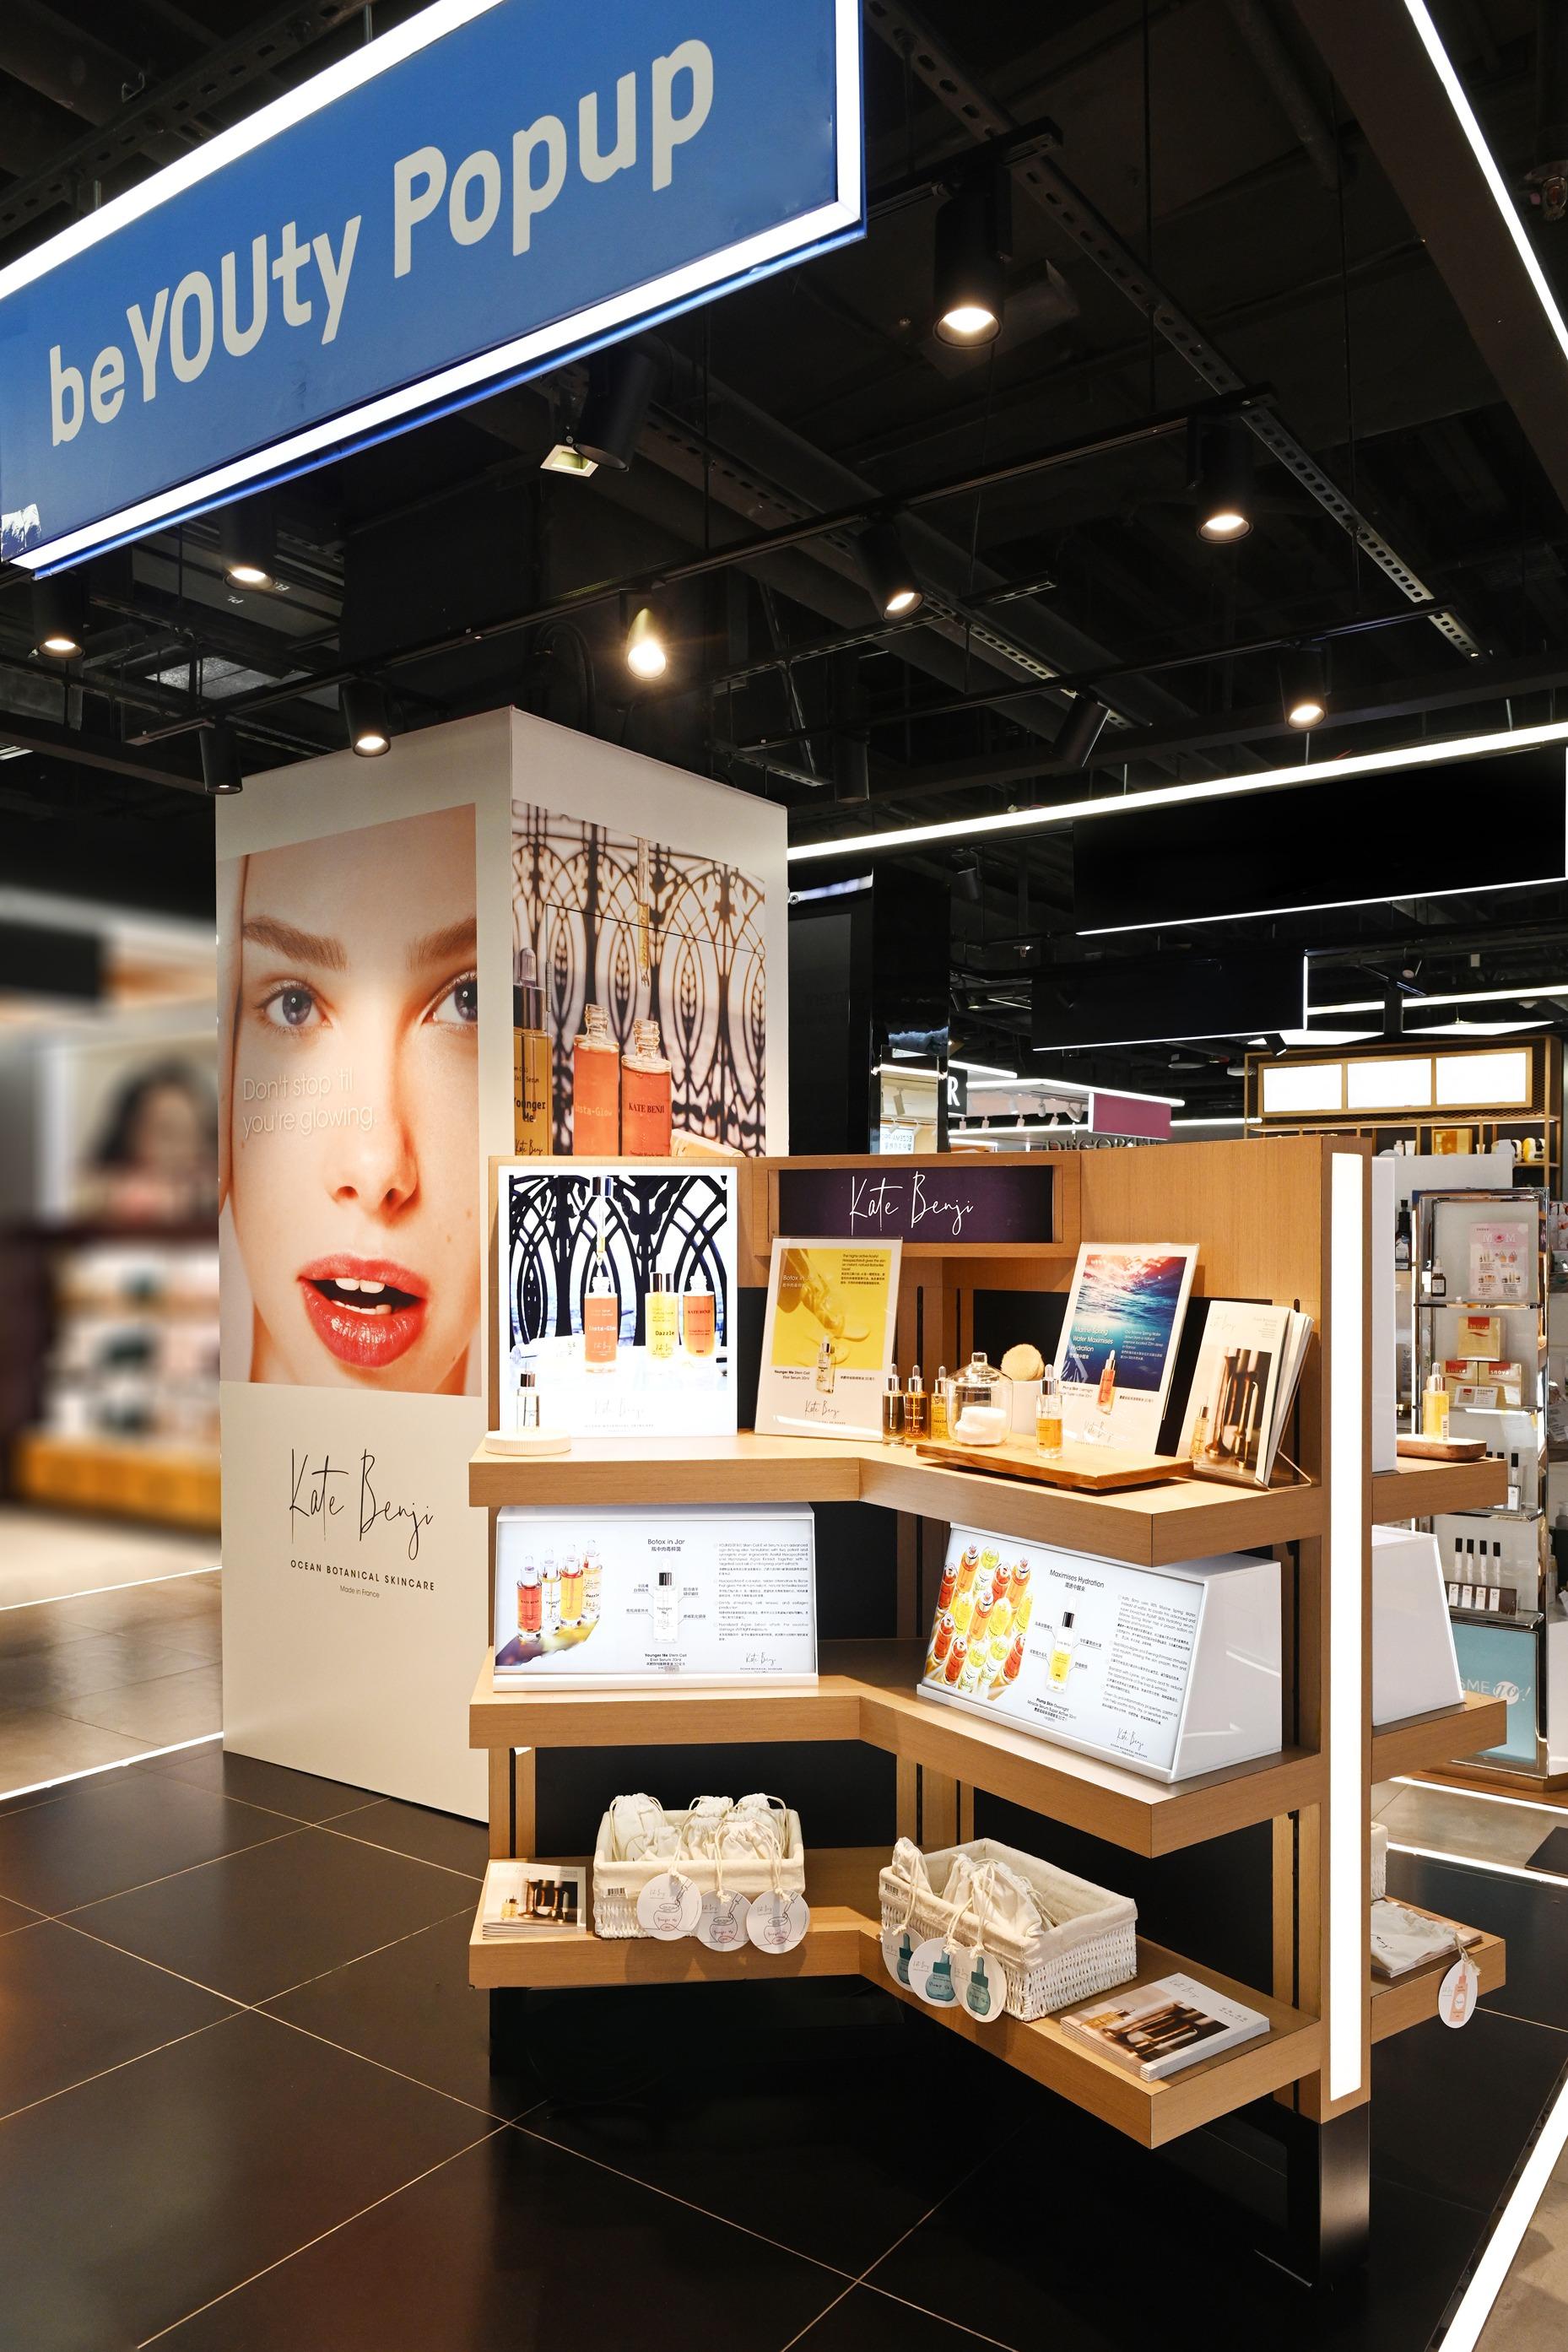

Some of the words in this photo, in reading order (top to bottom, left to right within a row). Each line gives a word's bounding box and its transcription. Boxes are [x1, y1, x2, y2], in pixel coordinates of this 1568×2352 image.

[50, 215, 361, 446] beYOUty
[393, 38, 713, 278] Popup
[243, 1073, 288, 1100] Don't
[294, 1073, 332, 1099] stop
[947, 1075, 960, 1106] R
[243, 1110, 295, 1139] you're
[300, 1103, 377, 1135] glowing.
[522, 1113, 534, 1122] Me
[629, 1102, 646, 1113] KATE
[850, 1176, 903, 1235] Kate
[911, 1171, 974, 1235] Benji
[289, 1448, 349, 1544] Kate
[359, 1448, 434, 1560] Benji
[290, 1560, 322, 1572] OCEAN
[327, 1565, 380, 1582] BOTANICAL
[384, 1575, 435, 1591] SKINCARE
[1050, 1569, 1078, 1582] Maximises
[1078, 1576, 1105, 1588] Hydration
[339, 1585, 355, 1594] Made
[361, 1588, 380, 1598] France
